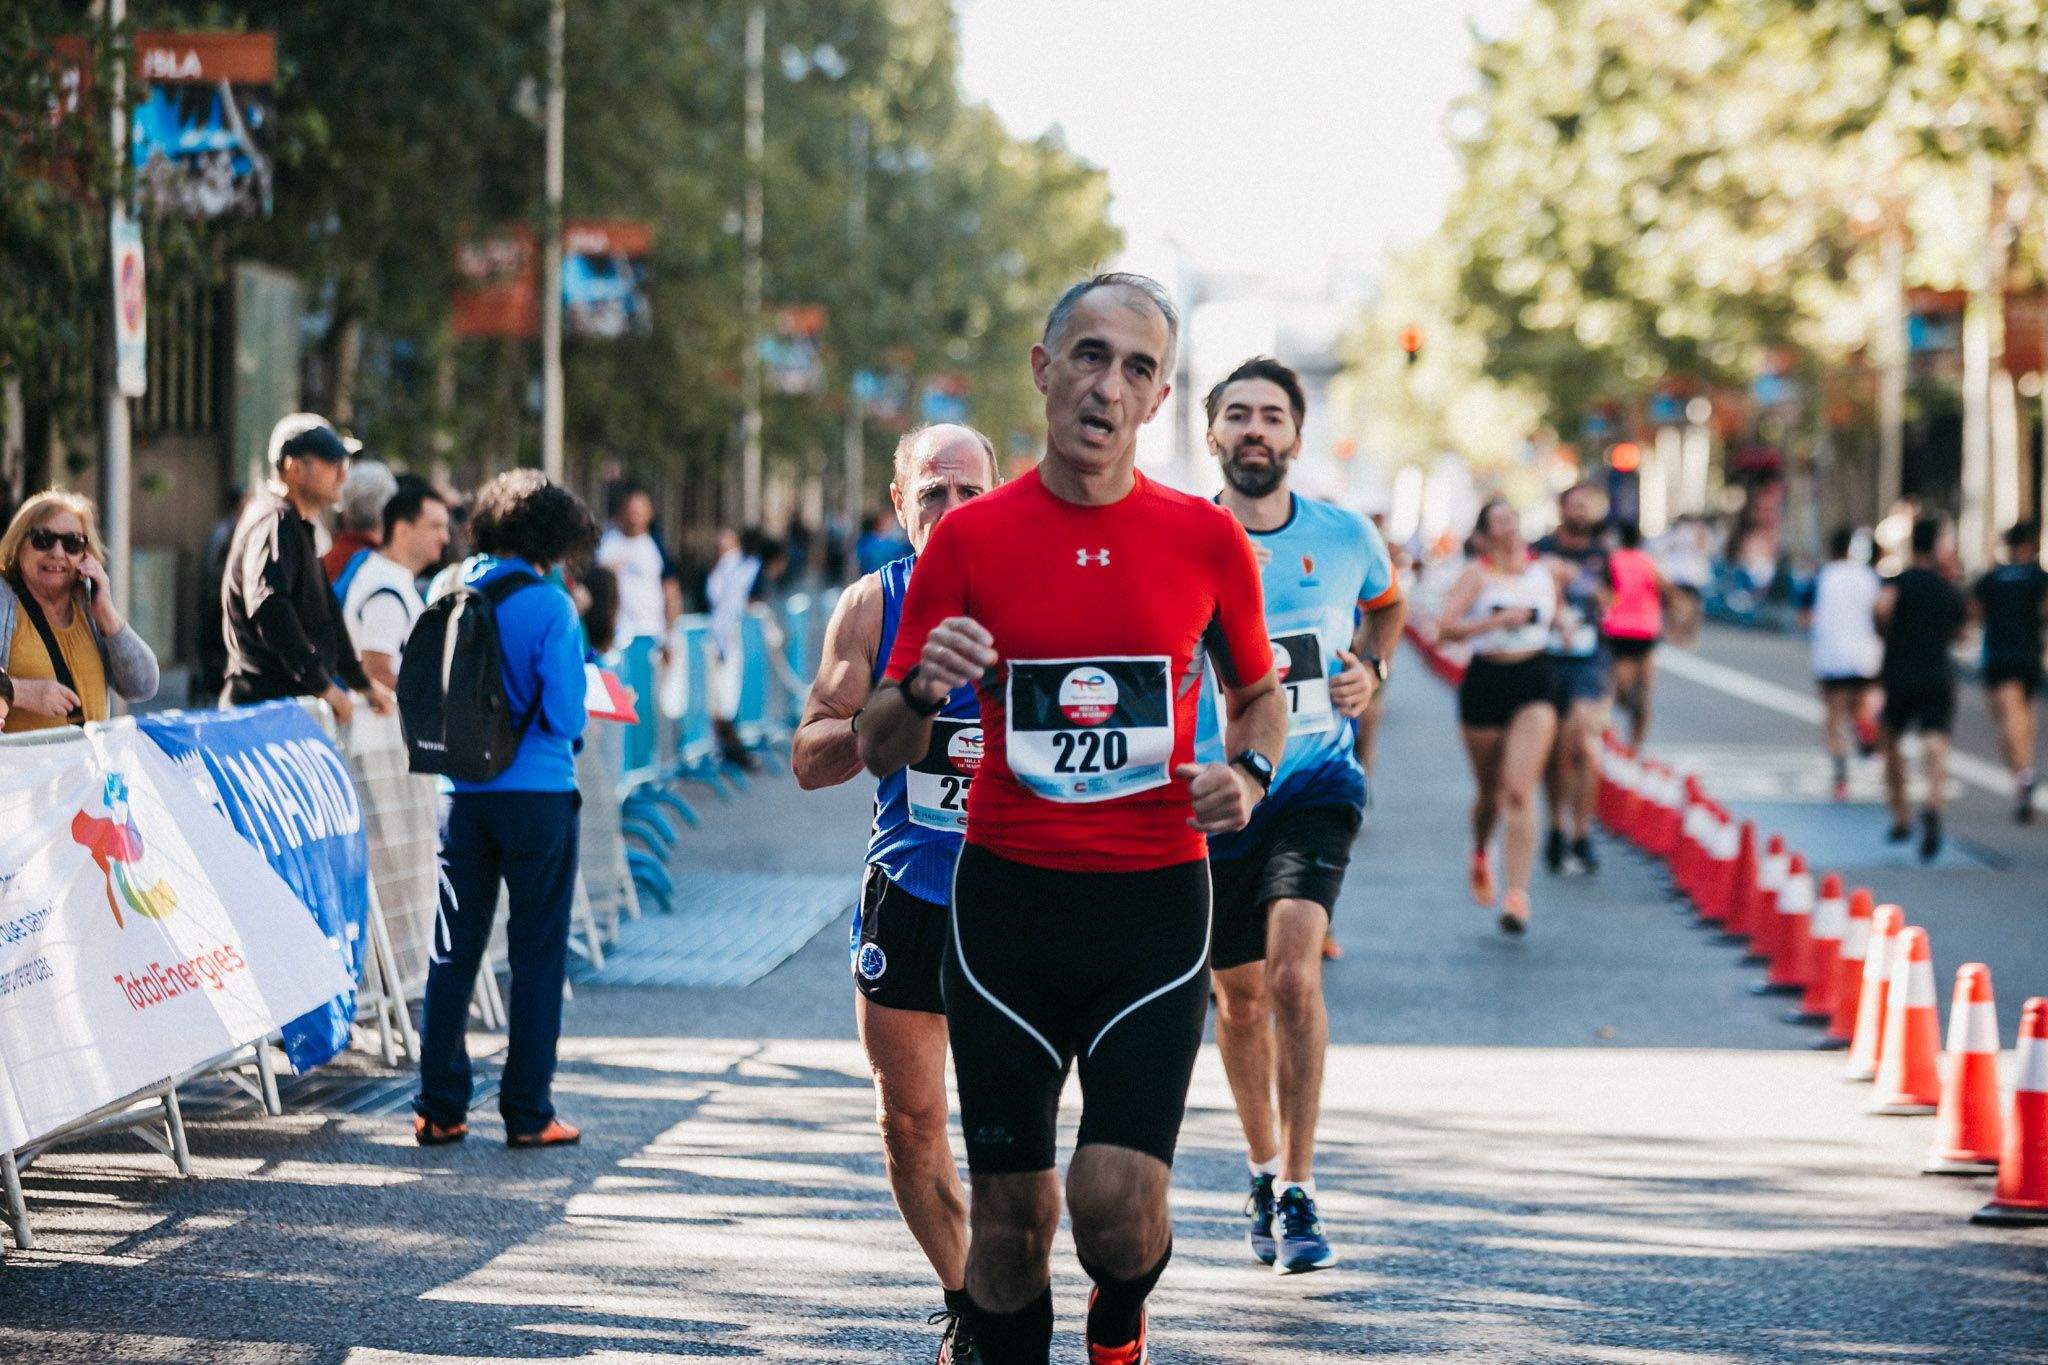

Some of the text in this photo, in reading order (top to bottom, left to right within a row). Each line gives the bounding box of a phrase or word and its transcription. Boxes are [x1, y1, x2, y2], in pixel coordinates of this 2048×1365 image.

[1053, 731, 1128, 773] 220
[226, 738, 360, 856] MADRID
[114, 943, 245, 1011] TotalEnergies
